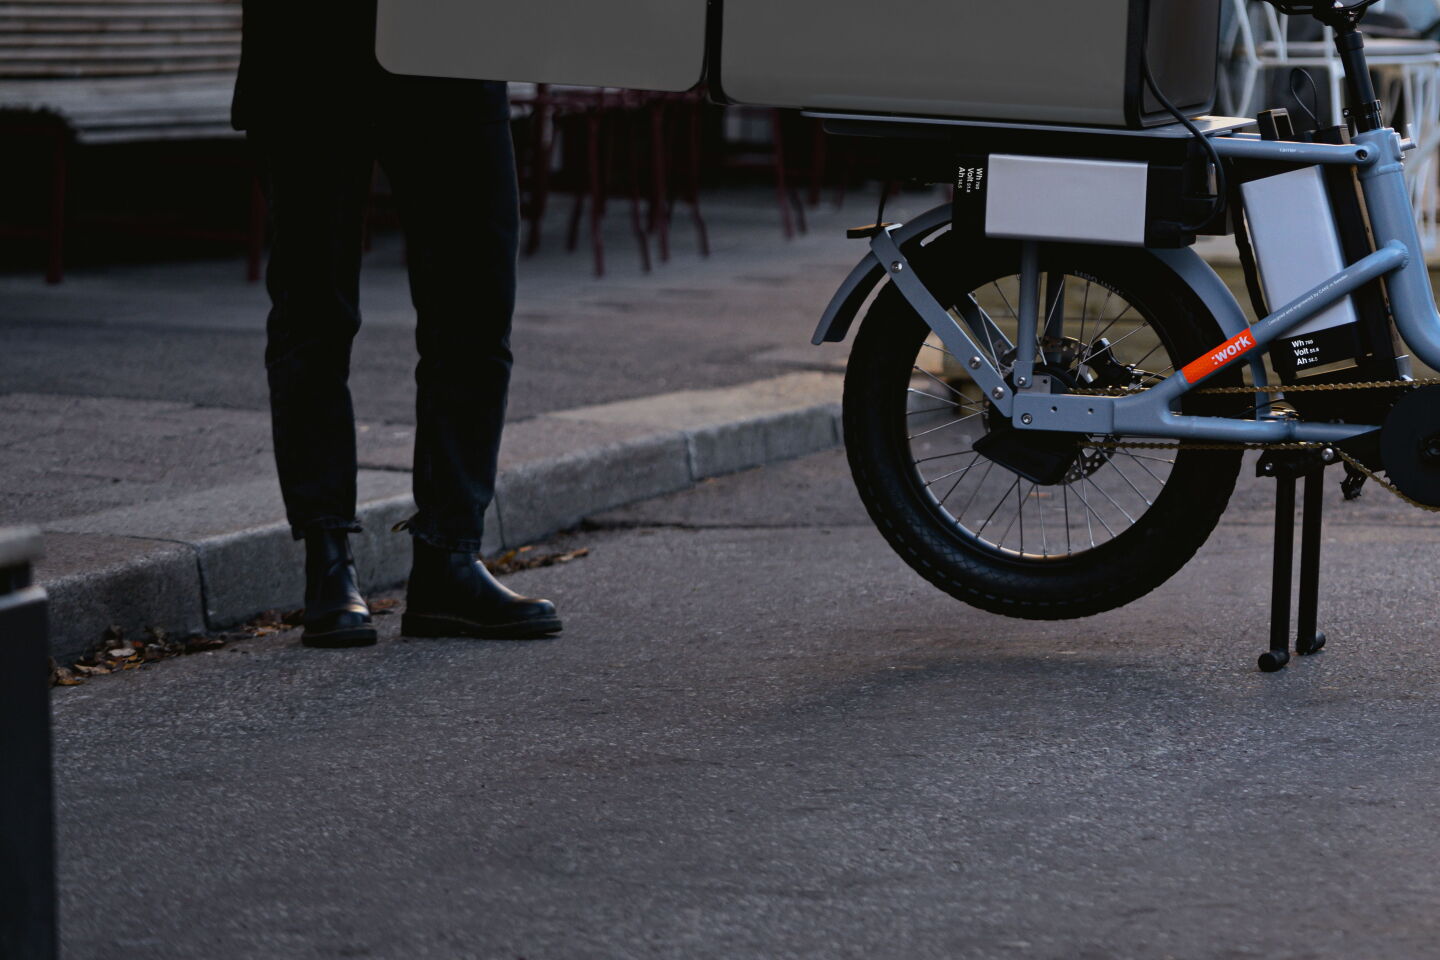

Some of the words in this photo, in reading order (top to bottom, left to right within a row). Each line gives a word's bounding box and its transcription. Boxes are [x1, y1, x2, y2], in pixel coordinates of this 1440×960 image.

[958, 166, 966, 178] Ah
[967, 167, 975, 182] Volt
[1291, 339, 1305, 348] Wh
[1294, 346, 1309, 357] Volt
[1296, 357, 1308, 366] Ah
